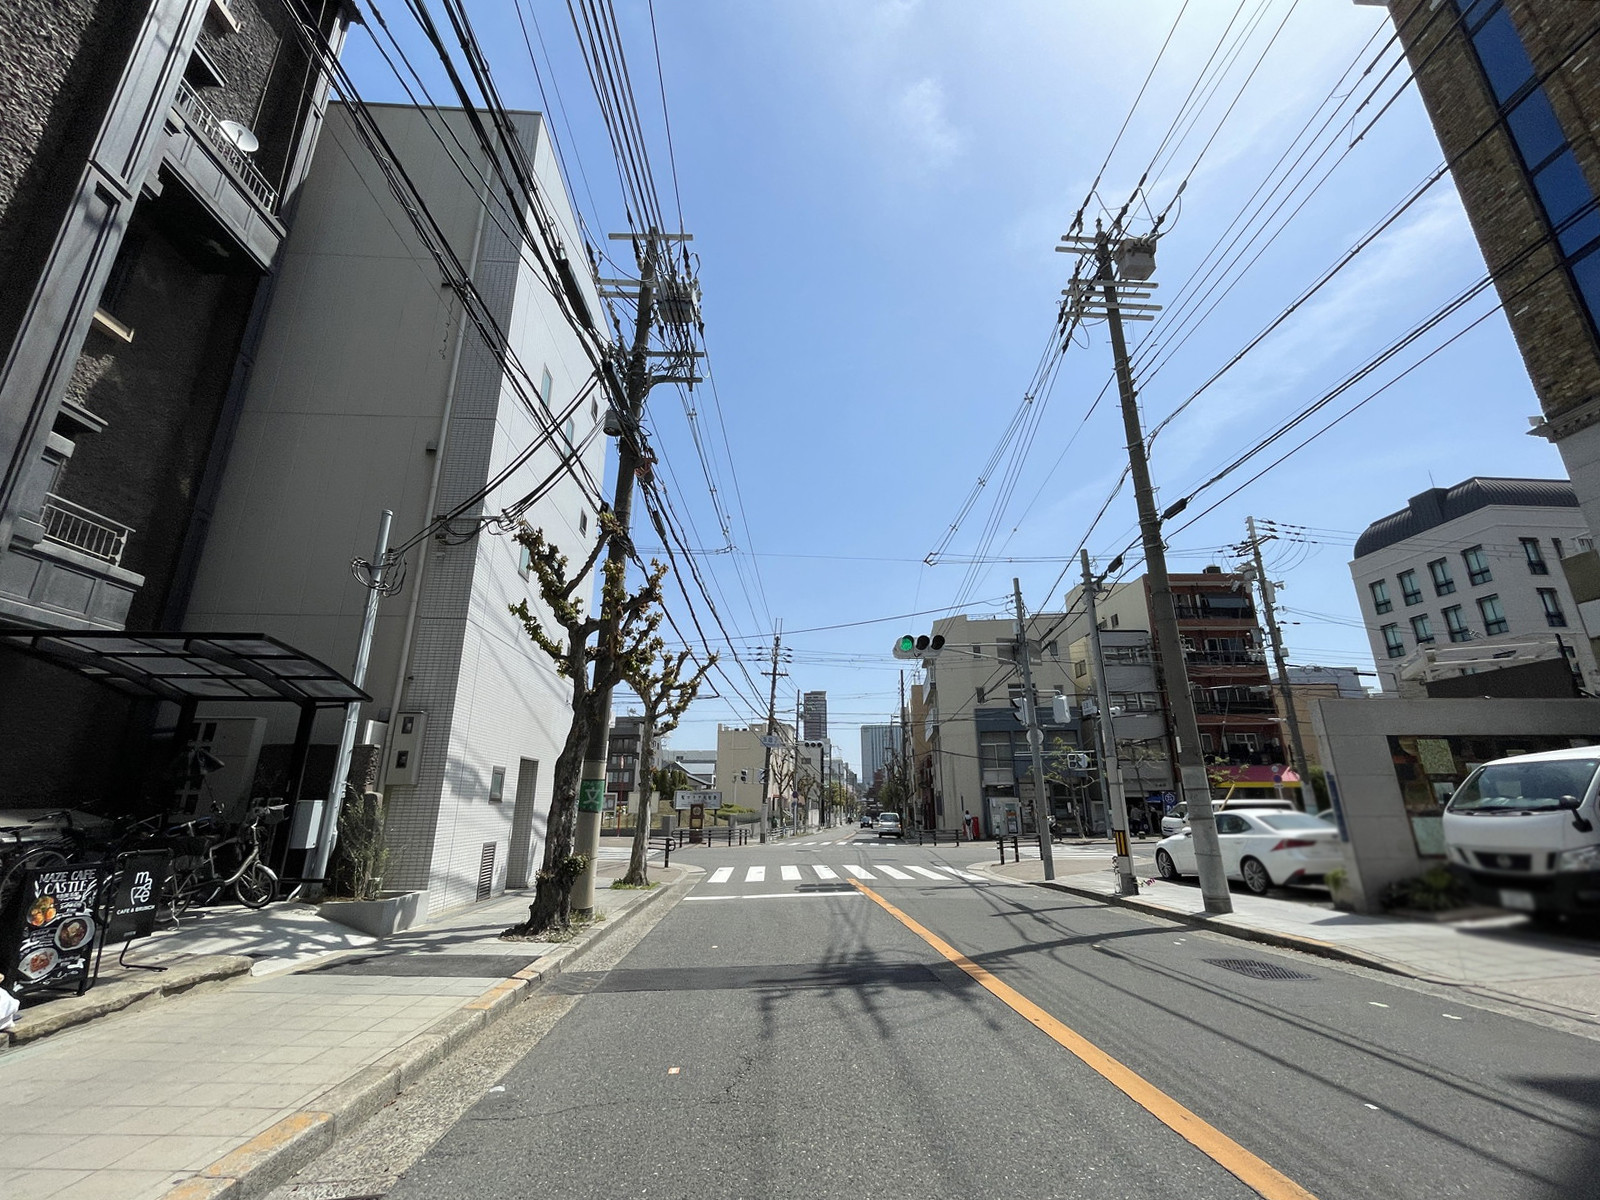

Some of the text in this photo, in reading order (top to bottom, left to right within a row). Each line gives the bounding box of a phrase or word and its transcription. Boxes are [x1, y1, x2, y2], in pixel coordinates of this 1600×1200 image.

[39, 869, 97, 883] MAZE CAFE
[43, 880, 88, 895] CASTLE
